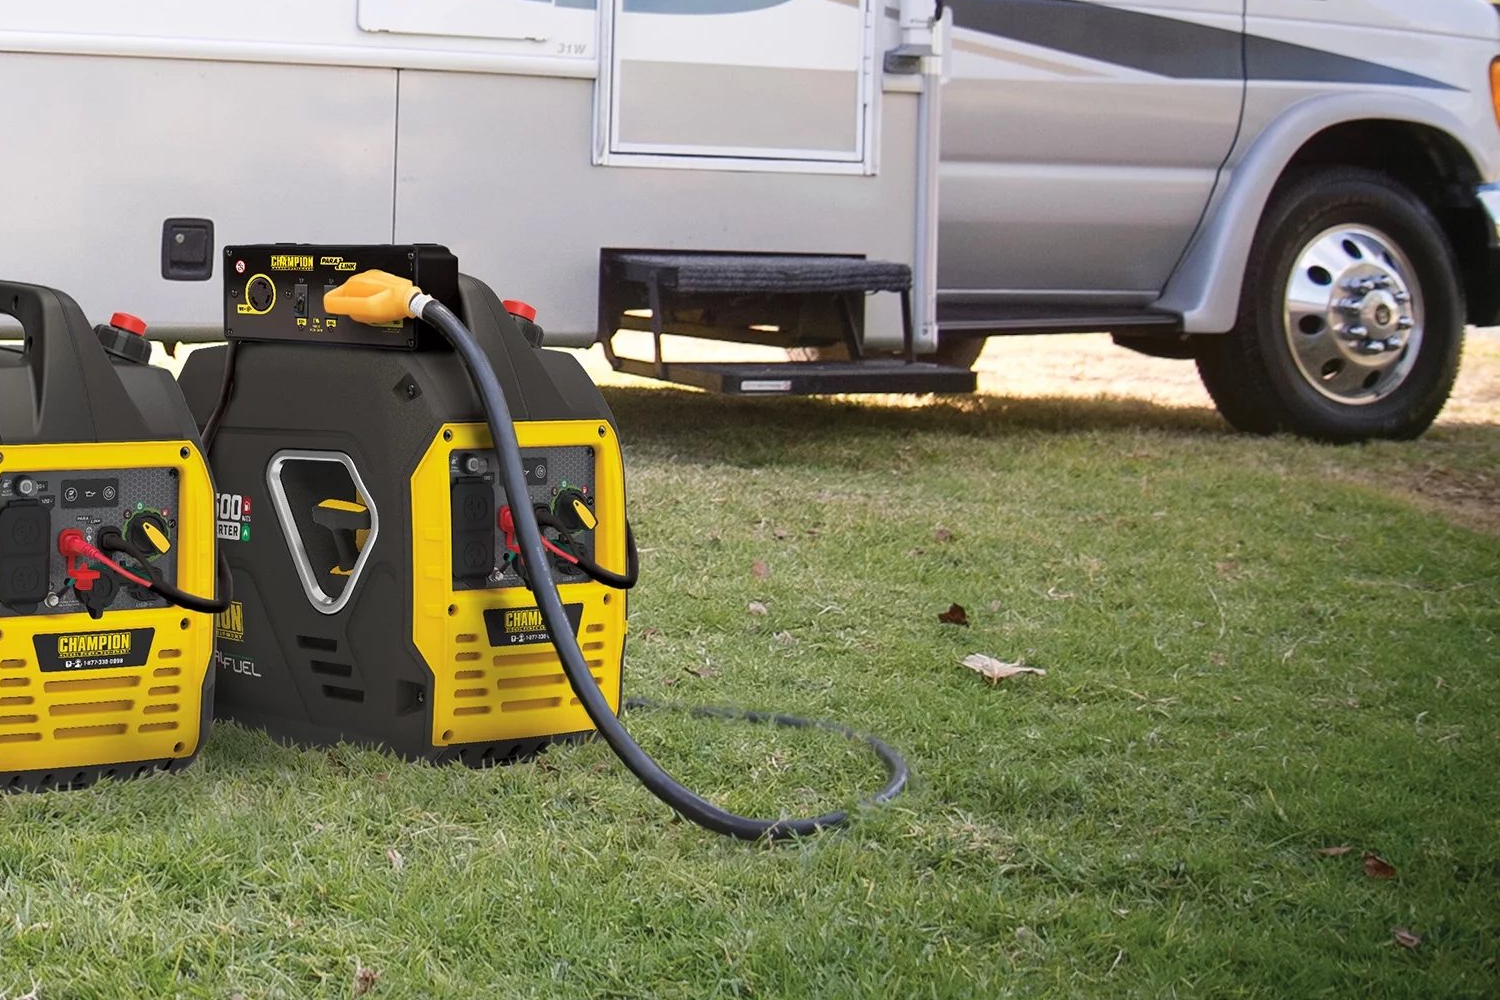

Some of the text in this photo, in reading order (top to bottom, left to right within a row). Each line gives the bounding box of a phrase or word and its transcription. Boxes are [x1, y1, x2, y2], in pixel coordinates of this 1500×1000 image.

[271, 255, 314, 268] CHAMPION
[218, 523, 239, 537] RTER
[58, 632, 131, 653] CHAMPION
